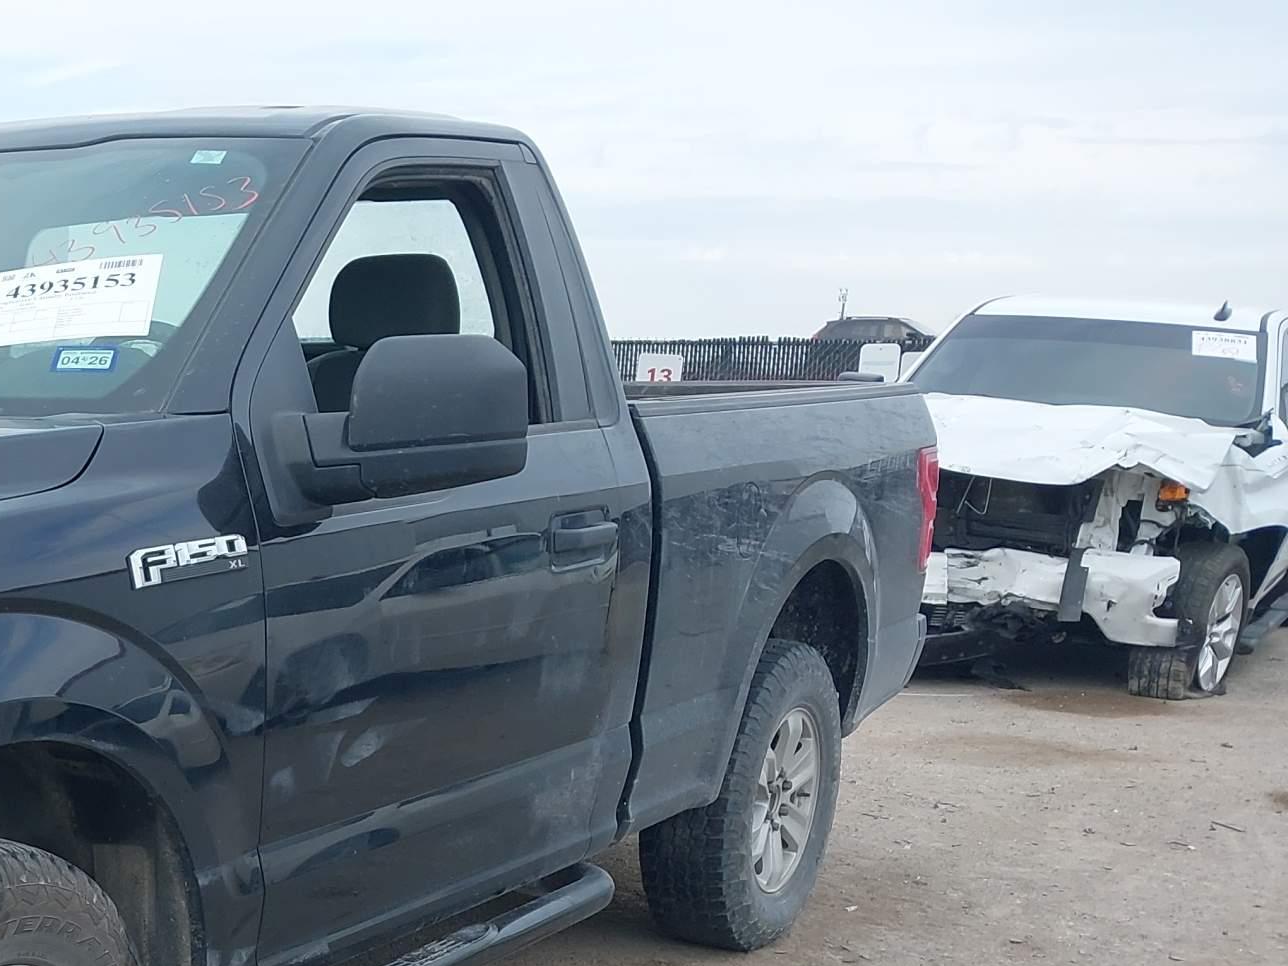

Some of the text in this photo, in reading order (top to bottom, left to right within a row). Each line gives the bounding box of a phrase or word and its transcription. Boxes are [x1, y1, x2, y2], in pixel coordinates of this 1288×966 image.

[5, 272, 136, 299] 43935153
[61, 356, 110, 366] 04 26
[647, 368, 673, 382] 13
[228, 560, 246, 569] XL
